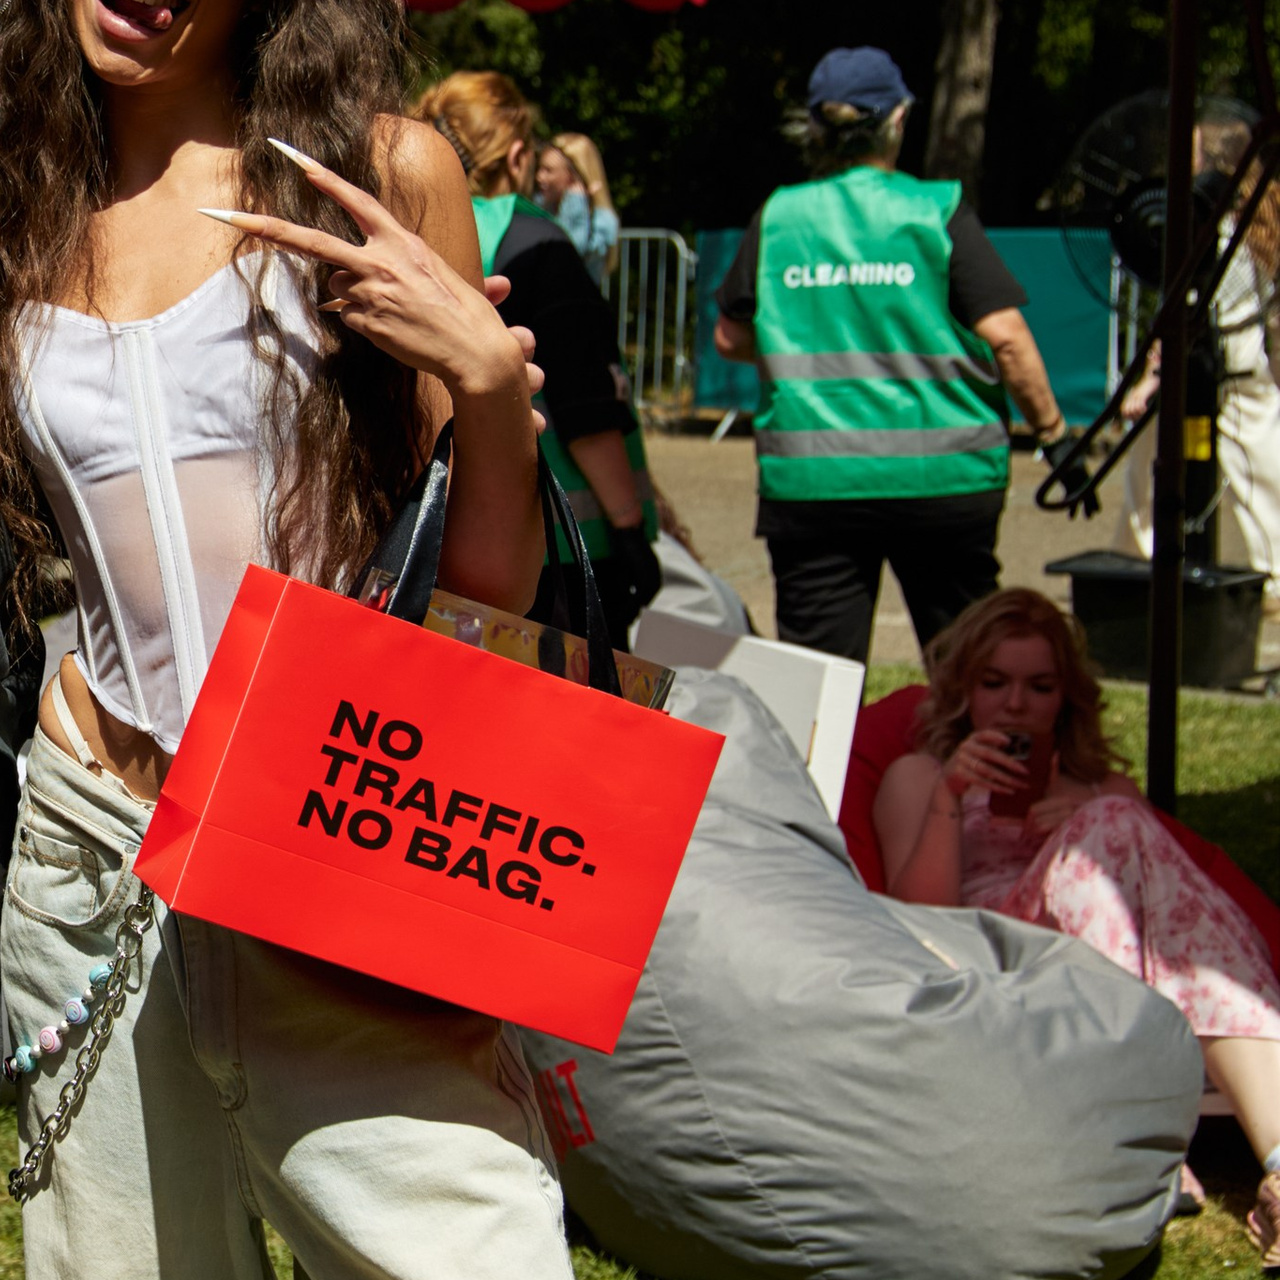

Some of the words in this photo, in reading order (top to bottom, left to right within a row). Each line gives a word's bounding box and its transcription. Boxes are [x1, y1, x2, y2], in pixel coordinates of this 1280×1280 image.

[782, 261, 916, 290] CLEANING
[329, 699, 423, 761] NO
[297, 789, 394, 851] NO
[404, 825, 556, 912] BAG.
[320, 744, 597, 877] TRAFFIC.
